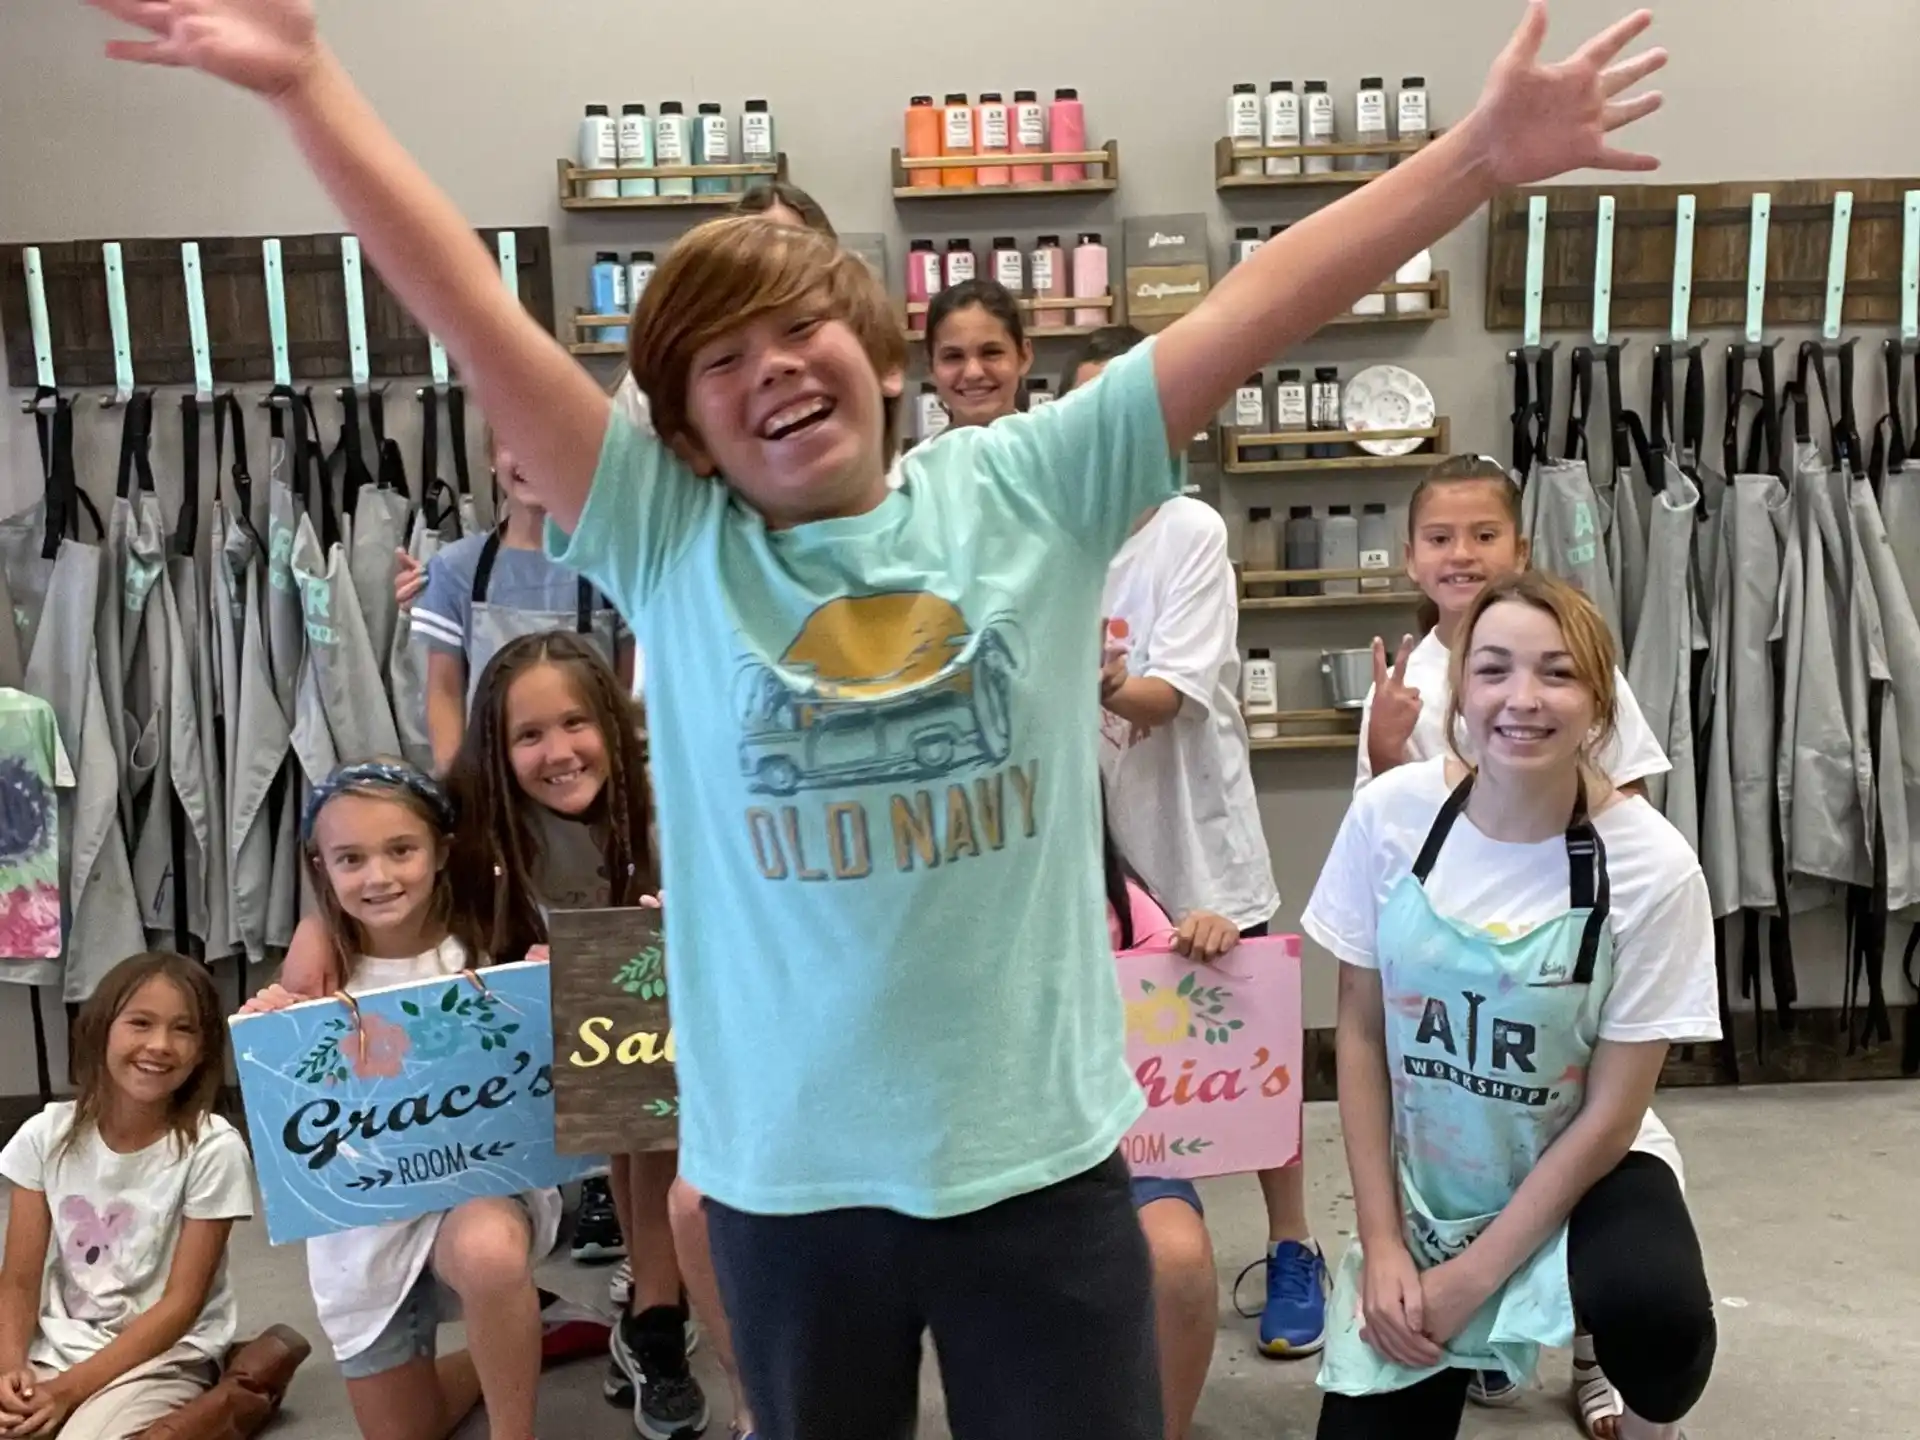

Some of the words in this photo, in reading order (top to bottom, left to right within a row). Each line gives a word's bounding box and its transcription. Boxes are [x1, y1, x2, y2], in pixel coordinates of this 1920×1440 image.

[746, 802, 872, 880] OLD
[890, 758, 1039, 872] NAVY
[282, 1050, 554, 1170] Grace's
[1409, 1059, 1541, 1104] WORKSHOP
[398, 1142, 468, 1184] ROOM
